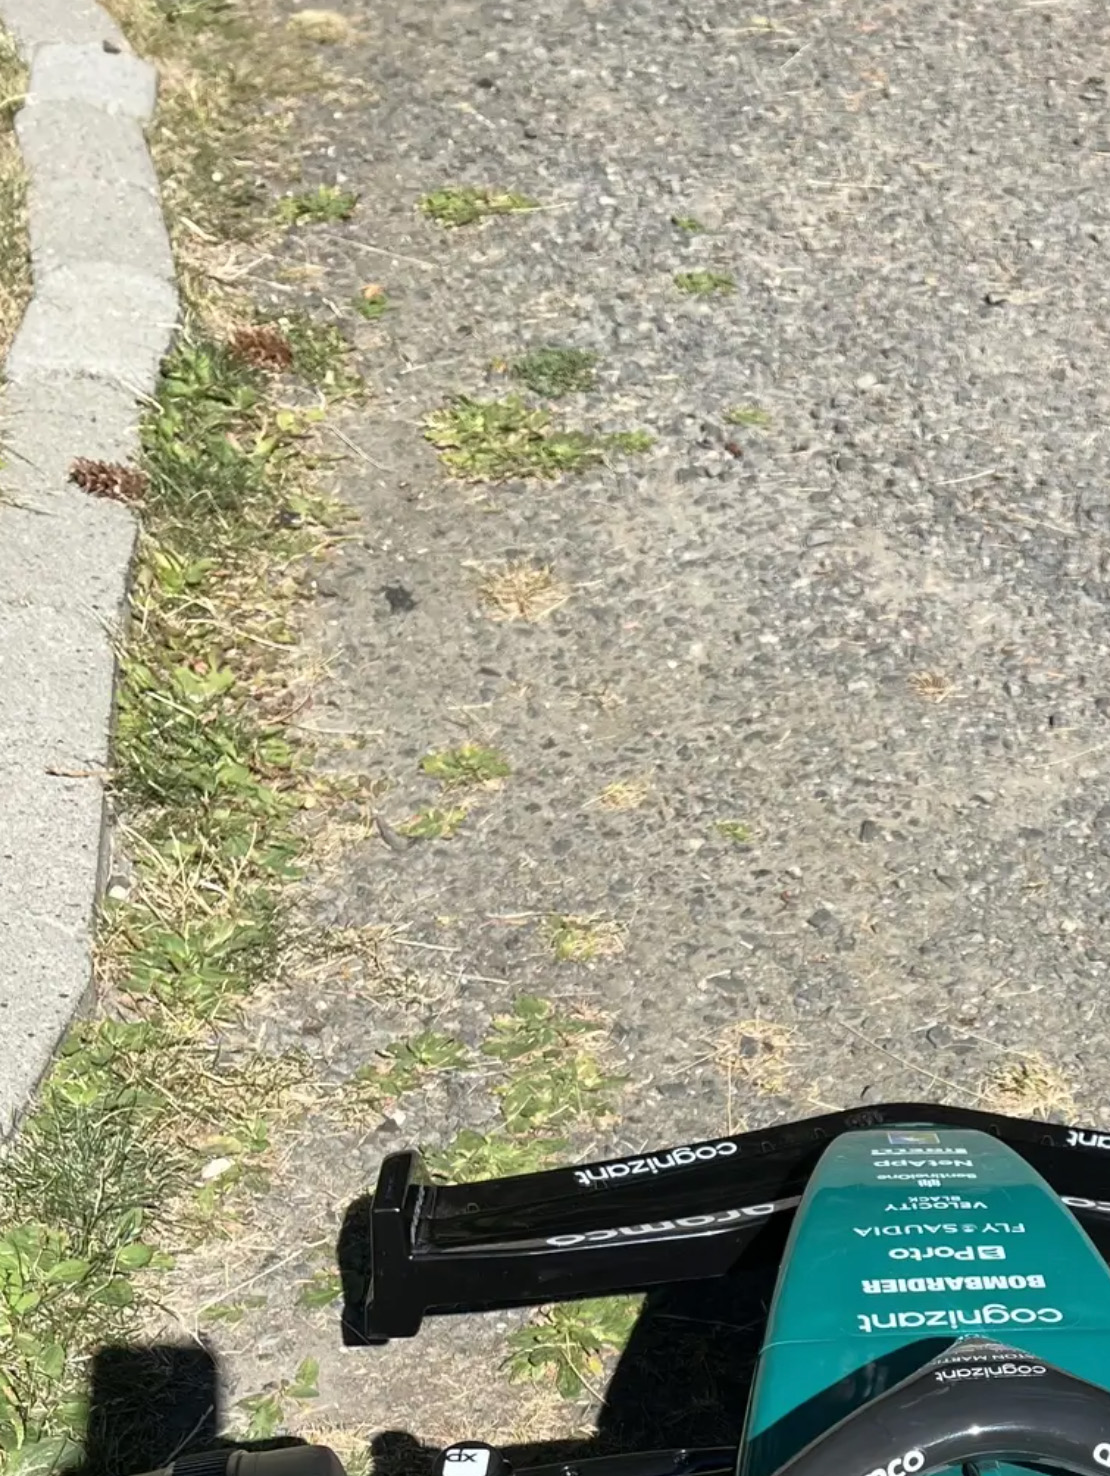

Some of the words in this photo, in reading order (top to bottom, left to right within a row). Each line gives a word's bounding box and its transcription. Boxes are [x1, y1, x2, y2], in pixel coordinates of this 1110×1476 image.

[574, 1141, 738, 1187] cognizant
[885, 1202, 988, 1211] VELOCITY
[546, 1203, 775, 1247] aramco
[853, 1223, 959, 1237] SAUDIA
[982, 1223, 1026, 1233] FLY
[888, 1246, 975, 1261] Porto
[861, 1275, 1046, 1294] BOMBARDIER
[857, 1304, 1063, 1332] cognizant
[993, 1353, 1035, 1361] STON
[935, 1363, 1046, 1382] cognizant
